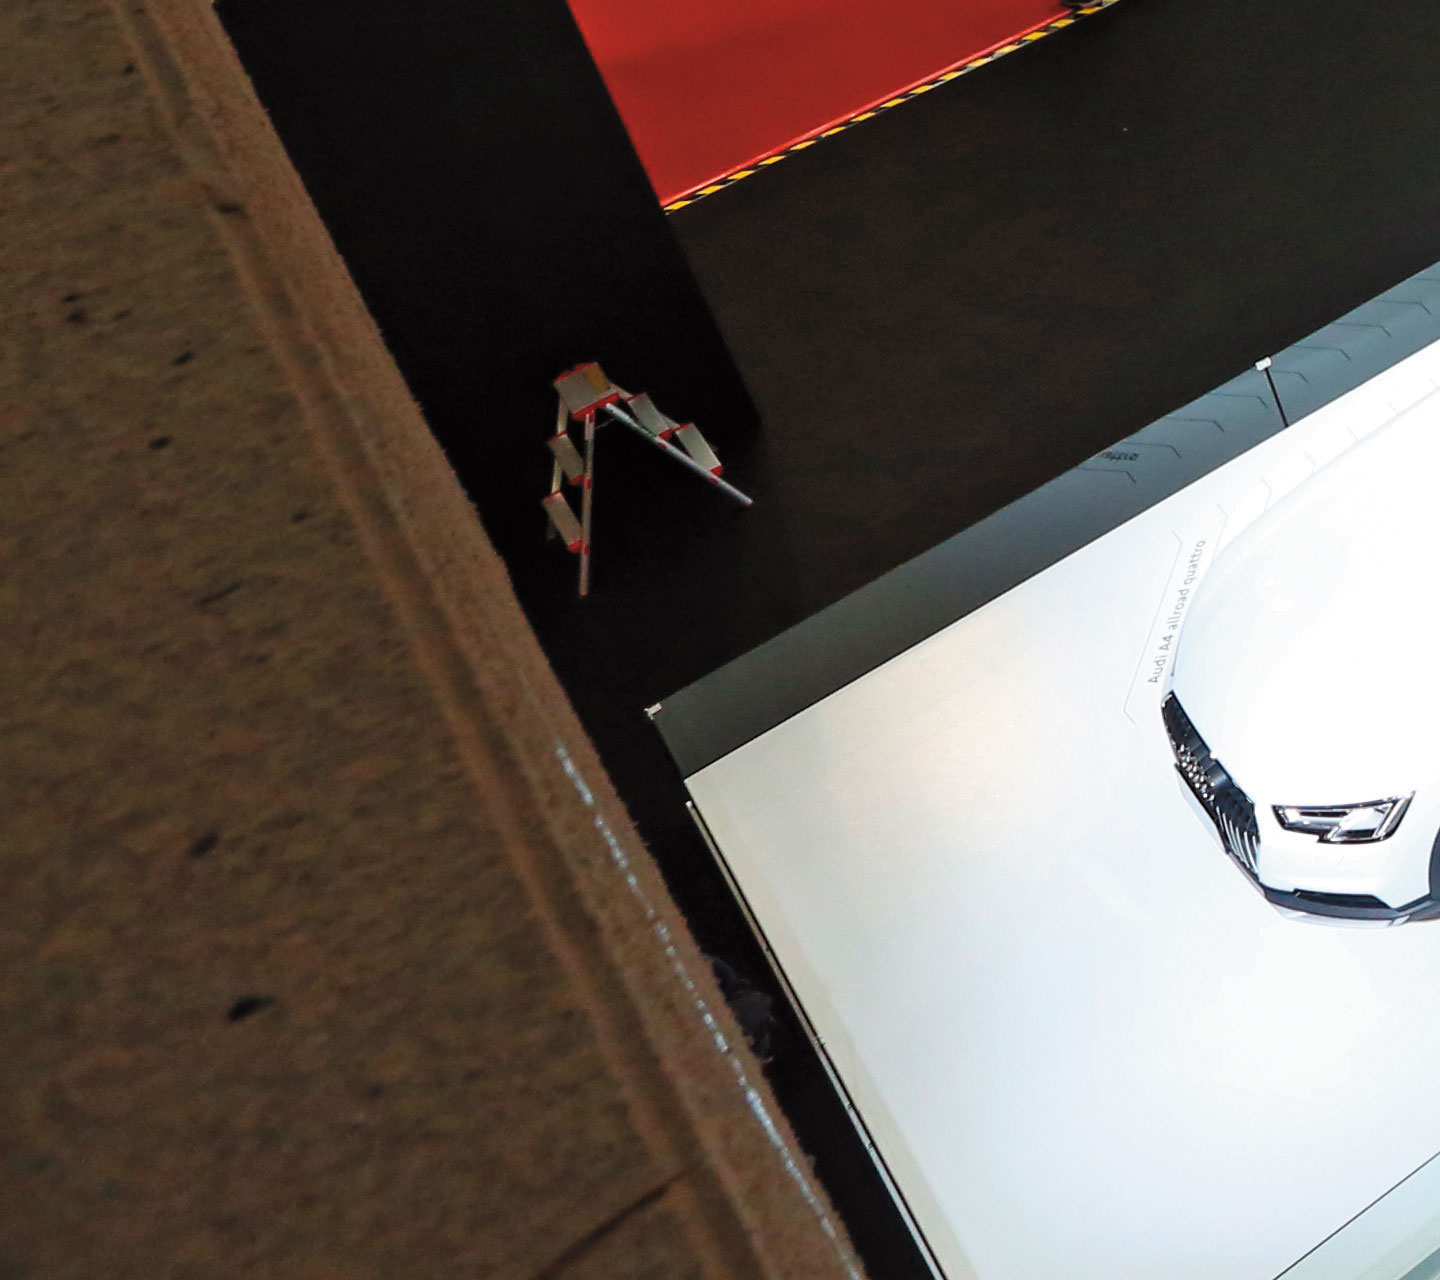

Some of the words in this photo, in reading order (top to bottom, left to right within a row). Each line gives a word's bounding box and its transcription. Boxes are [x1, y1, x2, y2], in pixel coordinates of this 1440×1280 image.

[1147, 655, 1166, 685] Audi
[1159, 633, 1173, 653] A4
[1168, 588, 1190, 633] allroad
[1181, 538, 1206, 585] quattro
